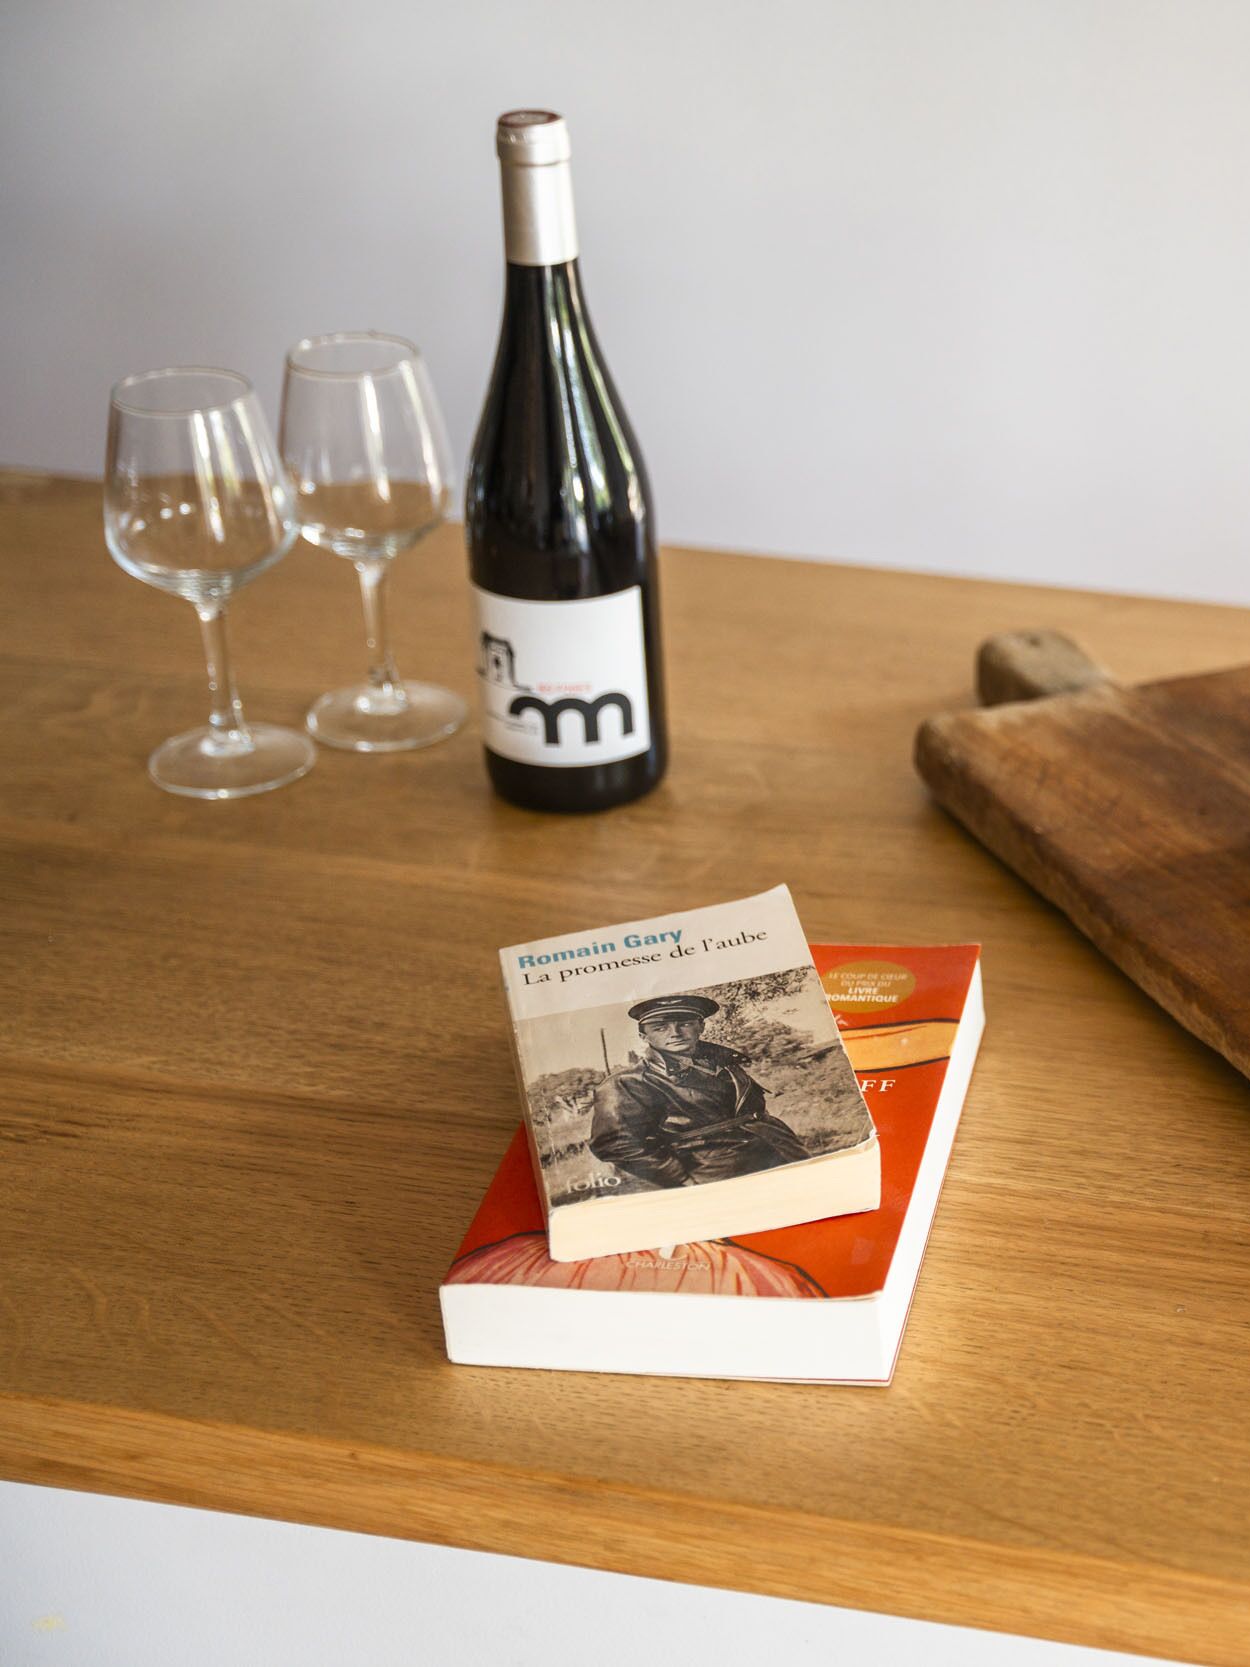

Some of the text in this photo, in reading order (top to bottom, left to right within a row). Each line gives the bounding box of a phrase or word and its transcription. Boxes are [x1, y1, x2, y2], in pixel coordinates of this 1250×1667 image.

[517, 929, 683, 969] Romain Gary
[523, 931, 768, 986] La promesse de l'aube
[840, 972, 866, 980] COUP
[848, 987, 879, 995] LIVRE
[566, 1172, 621, 1194] folio
[626, 1261, 711, 1271] CHARLESTON
